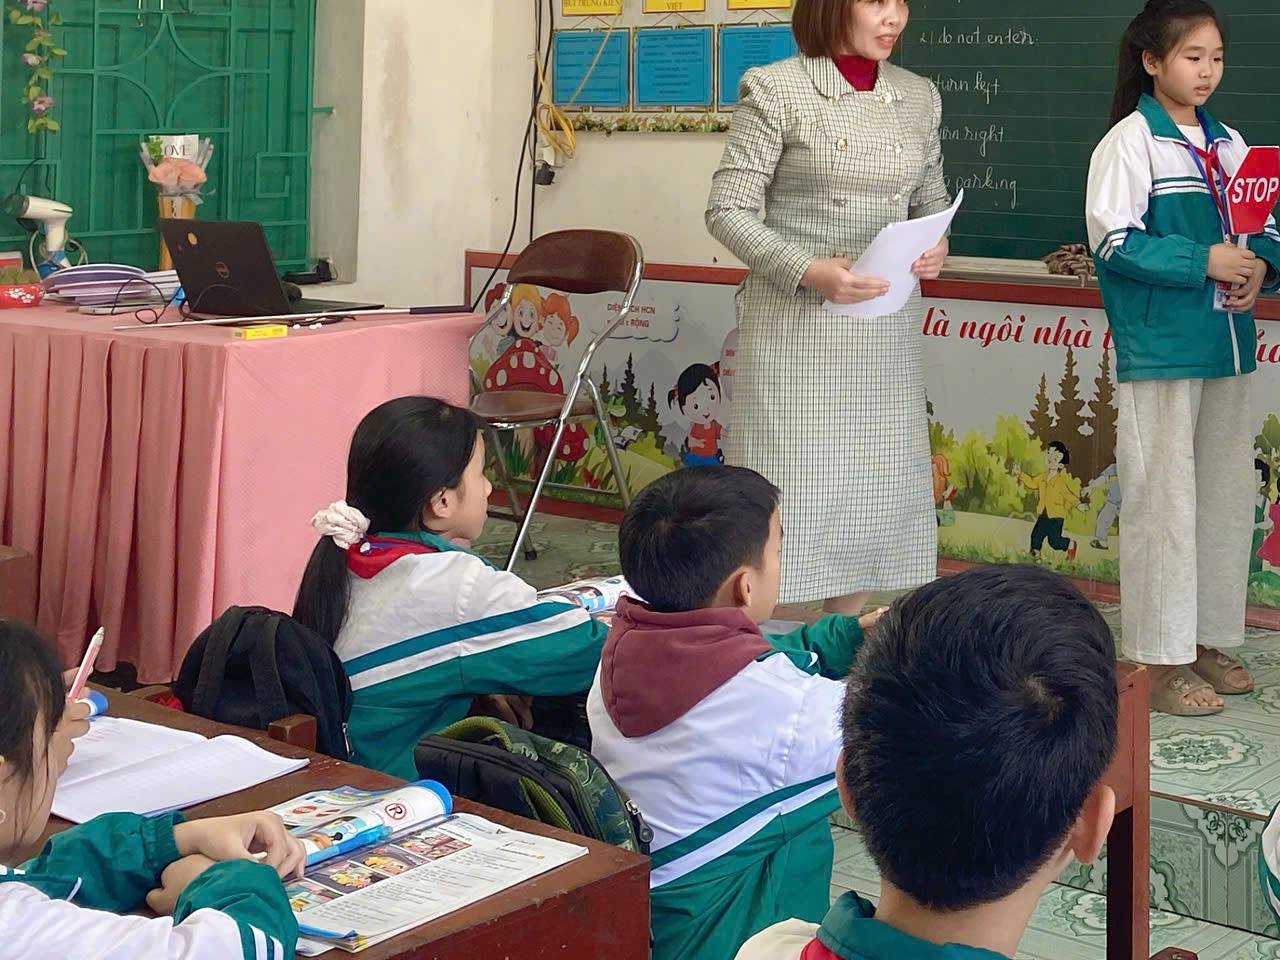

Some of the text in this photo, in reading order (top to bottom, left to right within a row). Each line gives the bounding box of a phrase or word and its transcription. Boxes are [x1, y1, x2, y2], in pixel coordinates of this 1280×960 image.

[938, 26, 952, 45] do
[957, 26, 980, 45] not
[934, 71, 1000, 104] turn left
[164, 144, 191, 156] OVE
[938, 125, 1005, 157] urn right
[956, 166, 1017, 209] parking
[1232, 177, 1279, 204] STOP
[921, 306, 951, 338] là
[959, 315, 1027, 346] ngôi
[1032, 313, 1094, 349] nhà
